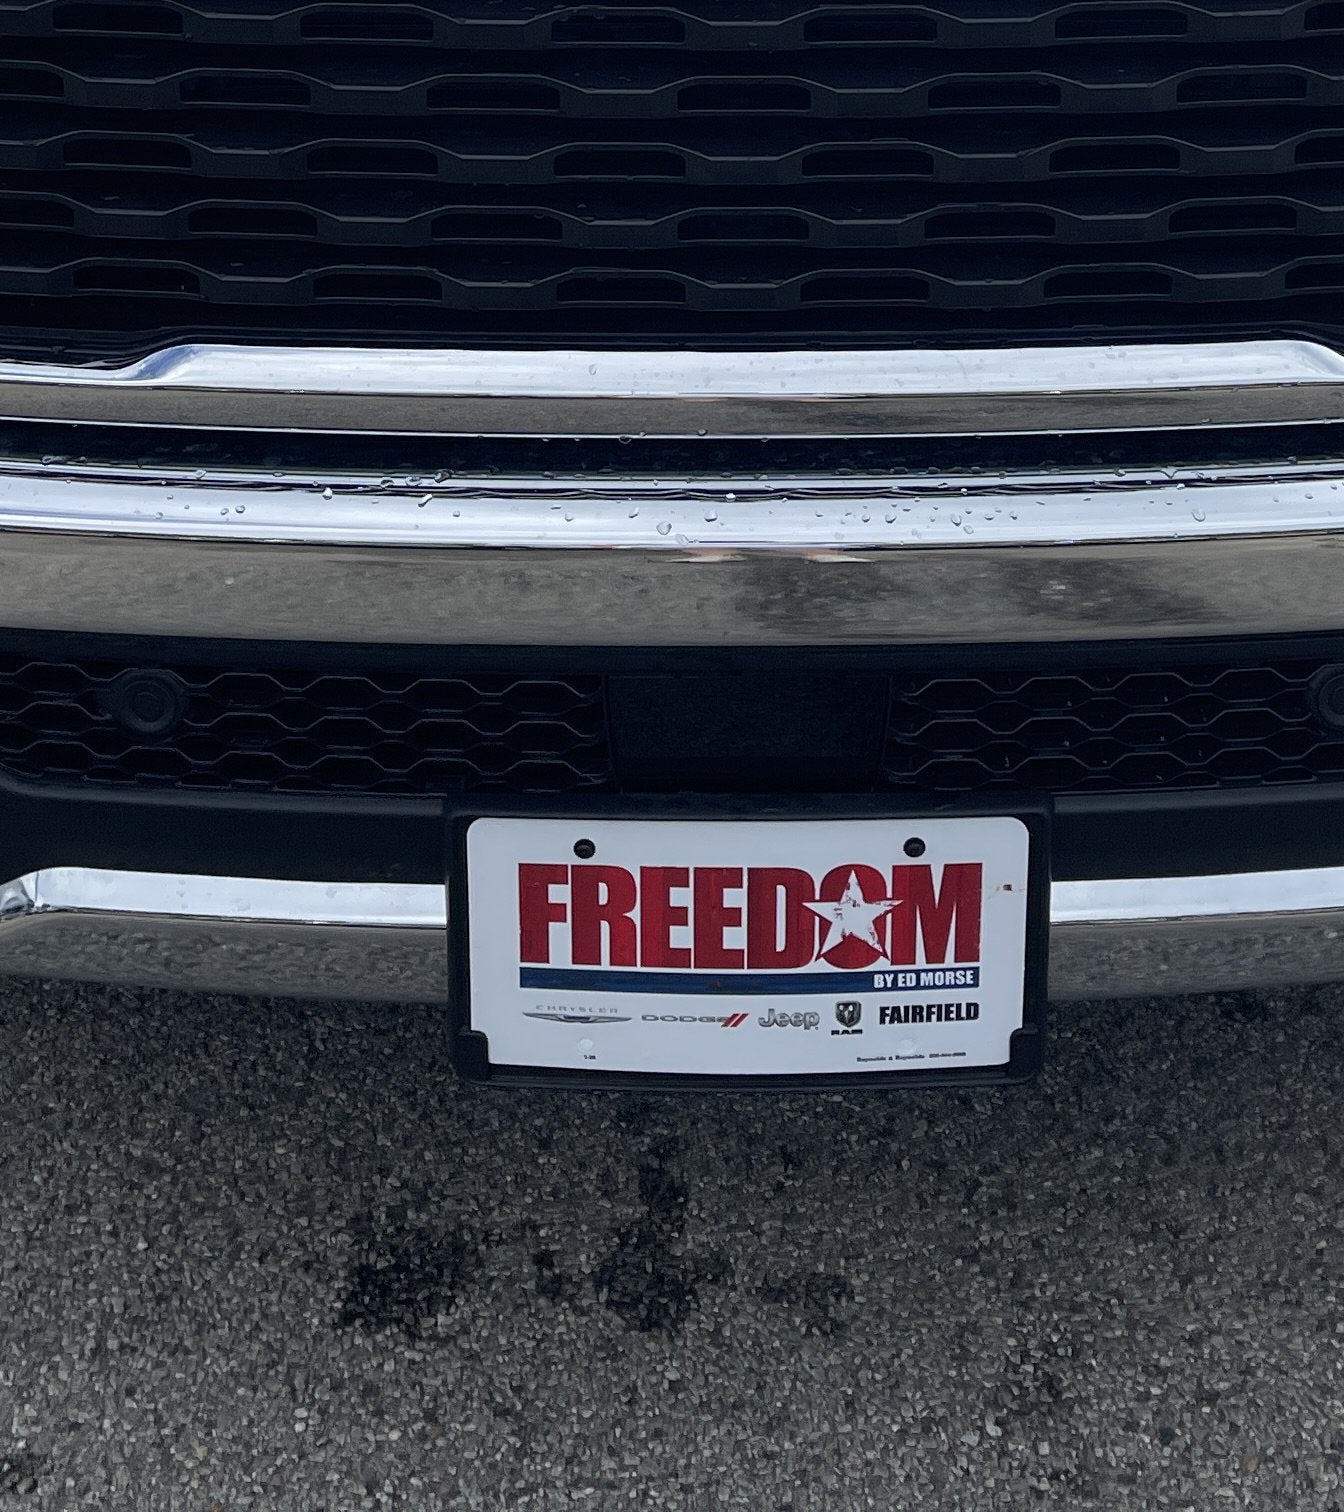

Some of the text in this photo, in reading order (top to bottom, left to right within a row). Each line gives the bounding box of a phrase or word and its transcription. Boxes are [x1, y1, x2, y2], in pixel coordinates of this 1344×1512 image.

[518, 862, 983, 970] FREEDOM
[873, 970, 975, 989] BY ED MORSE
[535, 1003, 619, 1014] CHRYSLER
[879, 1002, 980, 1025] FAIRFIELD
[758, 1008, 820, 1030] Jeep
[830, 1028, 863, 1036] RAM
